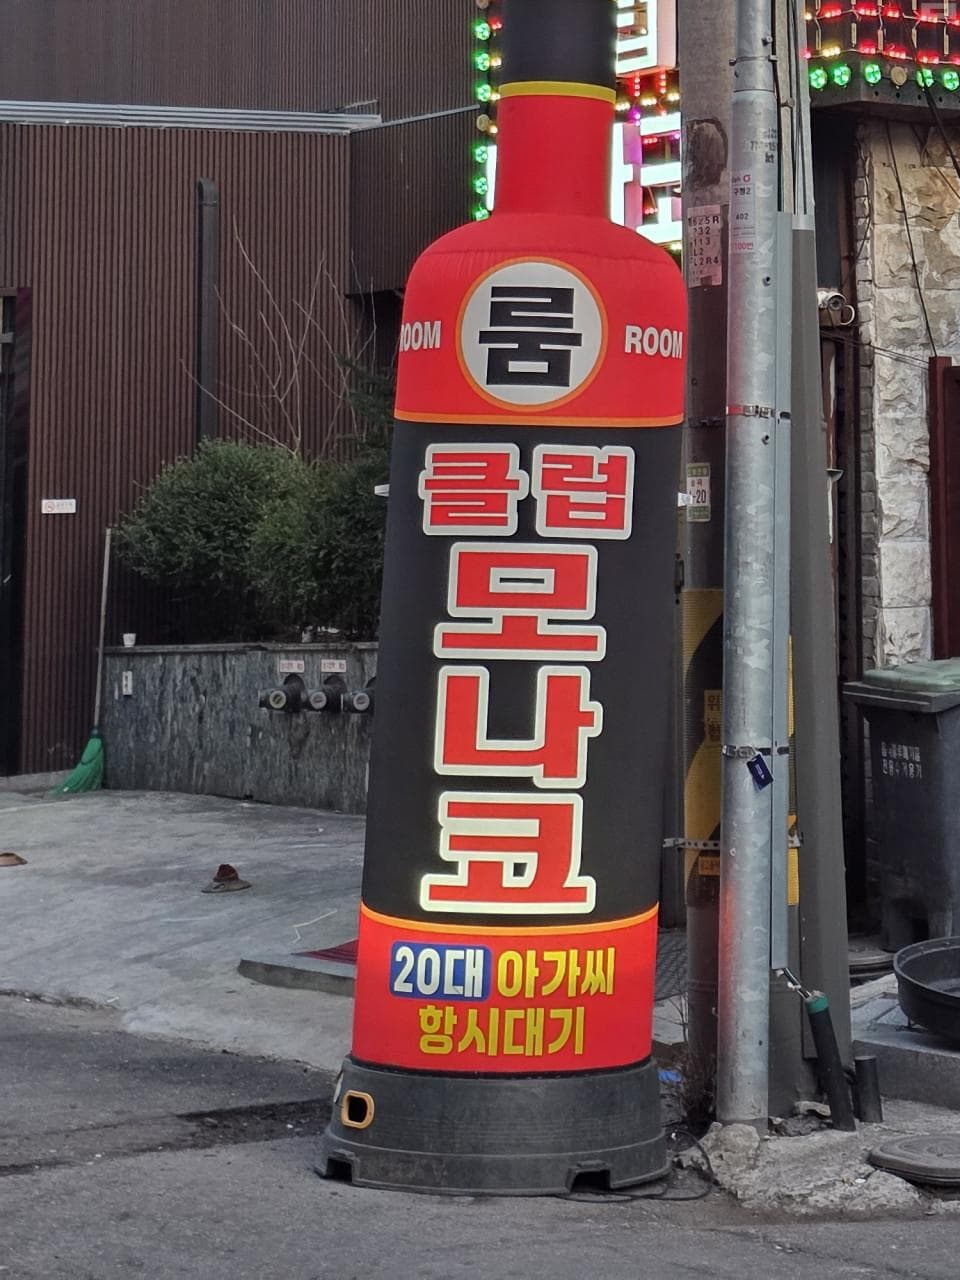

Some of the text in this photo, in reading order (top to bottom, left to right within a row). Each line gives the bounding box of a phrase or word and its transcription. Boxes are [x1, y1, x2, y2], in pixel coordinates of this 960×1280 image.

[479, 286, 583, 387] 룸
[624, 325, 683, 360] ROOM
[418, 444, 635, 540] 클럽
[421, 543, 608, 914] 모나코
[392, 946, 616, 999] 20대 아가씨
[418, 1004, 586, 1057] 항시대기
